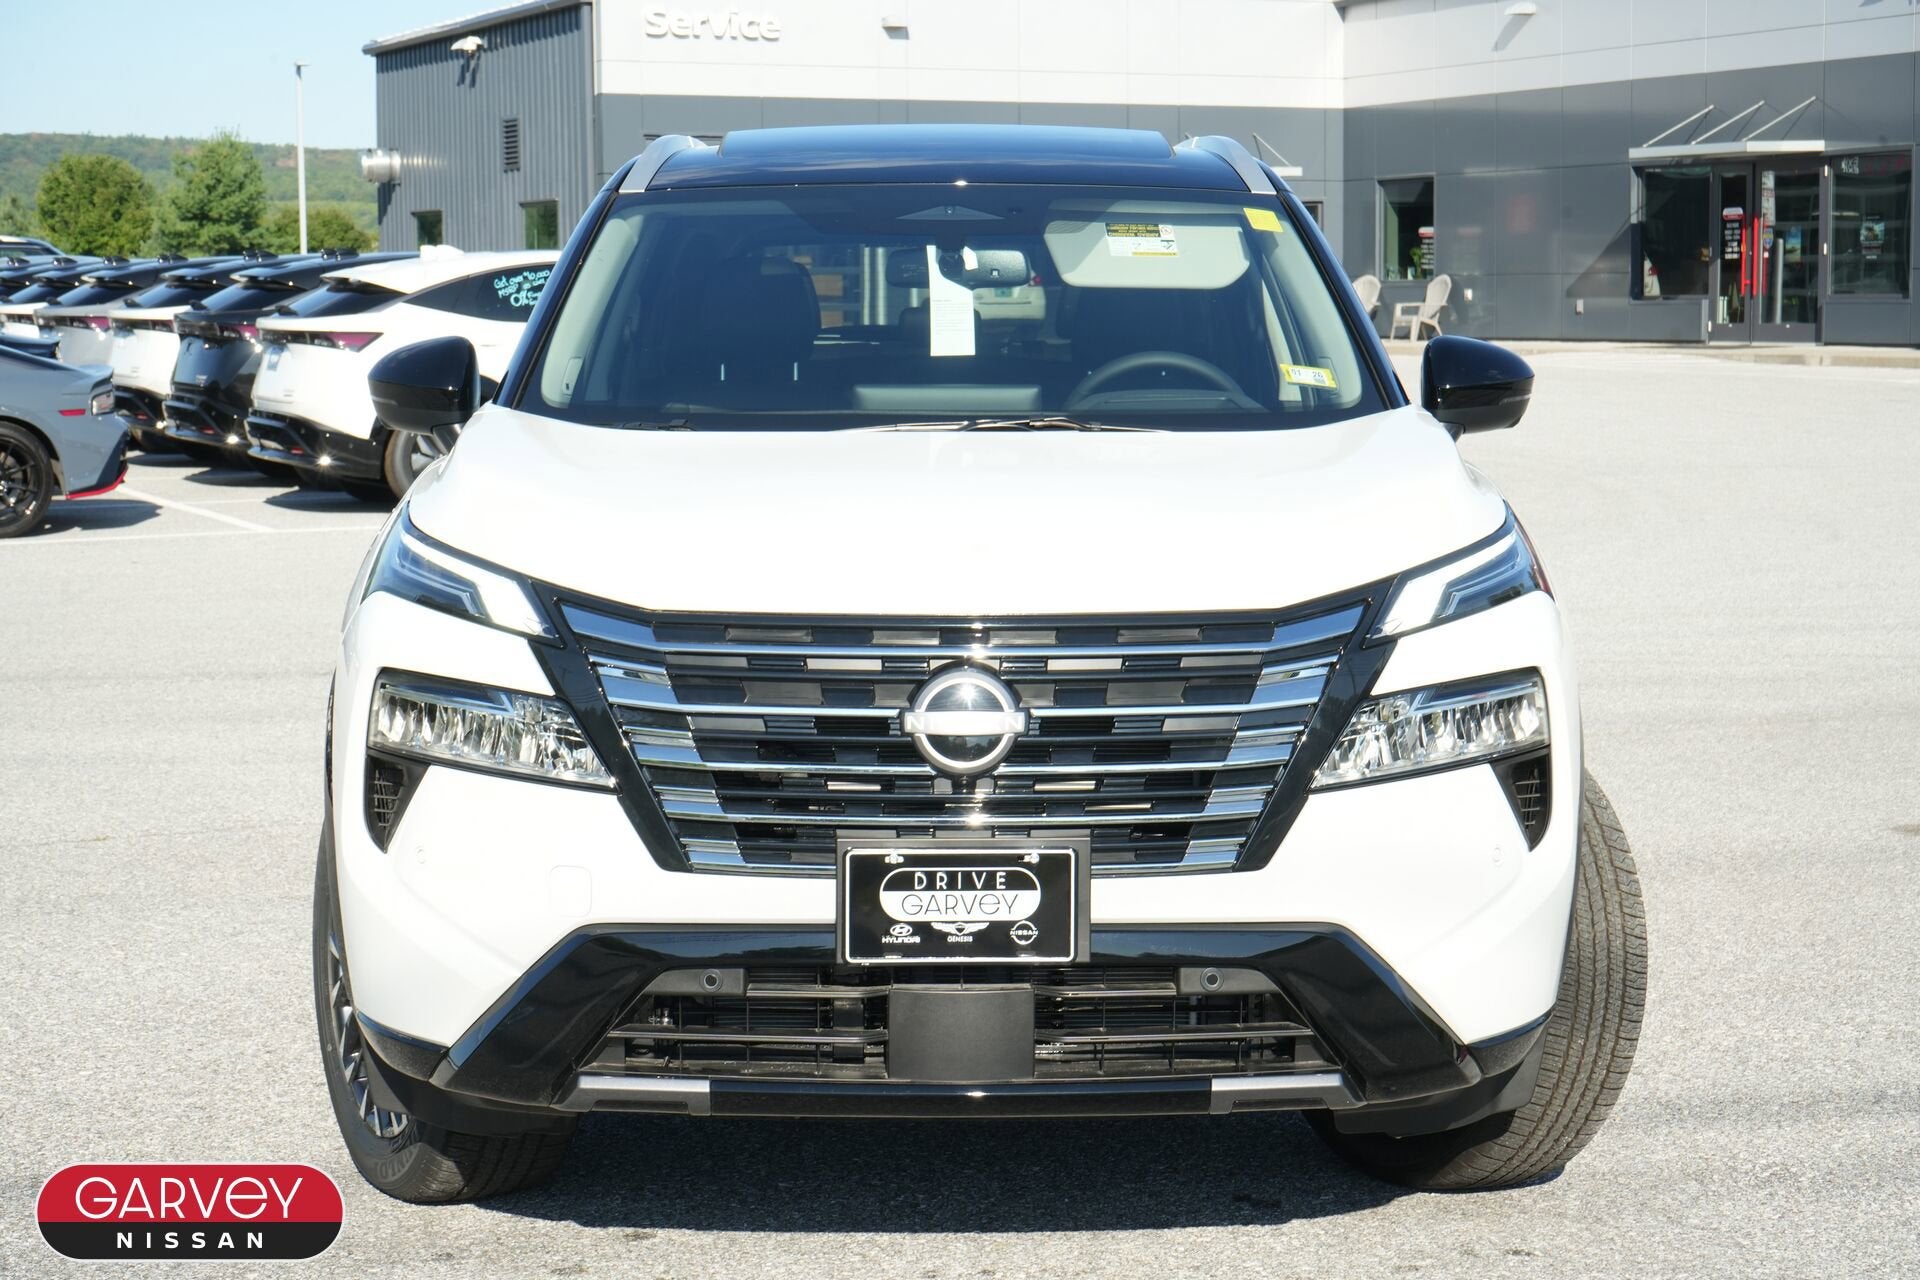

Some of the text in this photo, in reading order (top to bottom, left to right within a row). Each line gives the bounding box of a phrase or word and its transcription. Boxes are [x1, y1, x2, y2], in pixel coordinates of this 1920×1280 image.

[644, 8, 781, 42] Service
[914, 871, 1007, 890] DRIVE
[881, 935, 973, 944] HYUNDAI GENESIS
